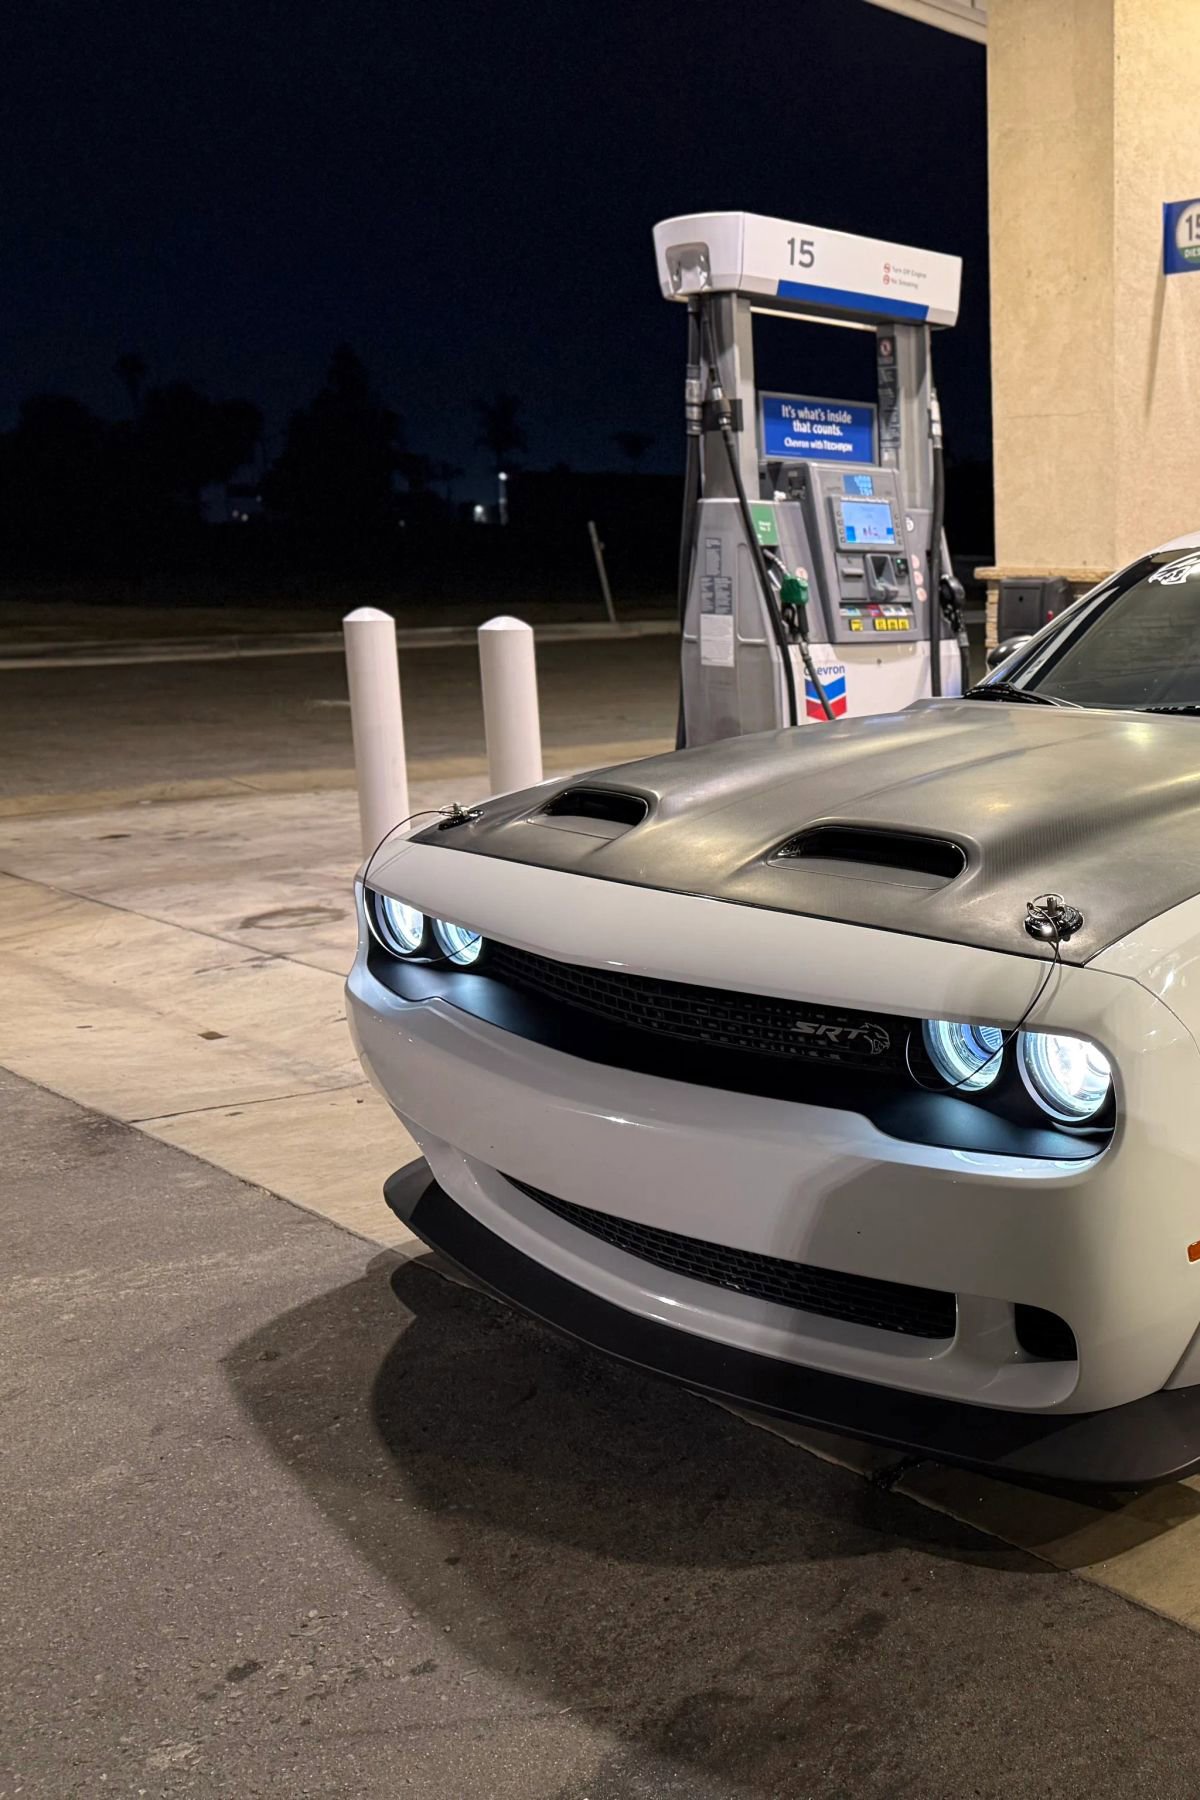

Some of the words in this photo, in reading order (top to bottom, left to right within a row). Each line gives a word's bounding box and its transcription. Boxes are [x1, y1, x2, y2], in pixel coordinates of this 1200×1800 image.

[787, 237, 815, 268] 15
[781, 404, 796, 418] It's
[797, 406, 825, 421] what's
[827, 409, 852, 424] inside
[792, 420, 811, 433] that
[813, 423, 843, 436] counts.
[784, 437, 809, 447] Chevron
[810, 440, 823, 450] with
[803, 665, 845, 676] Cevron
[790, 1021, 869, 1042] SRT
